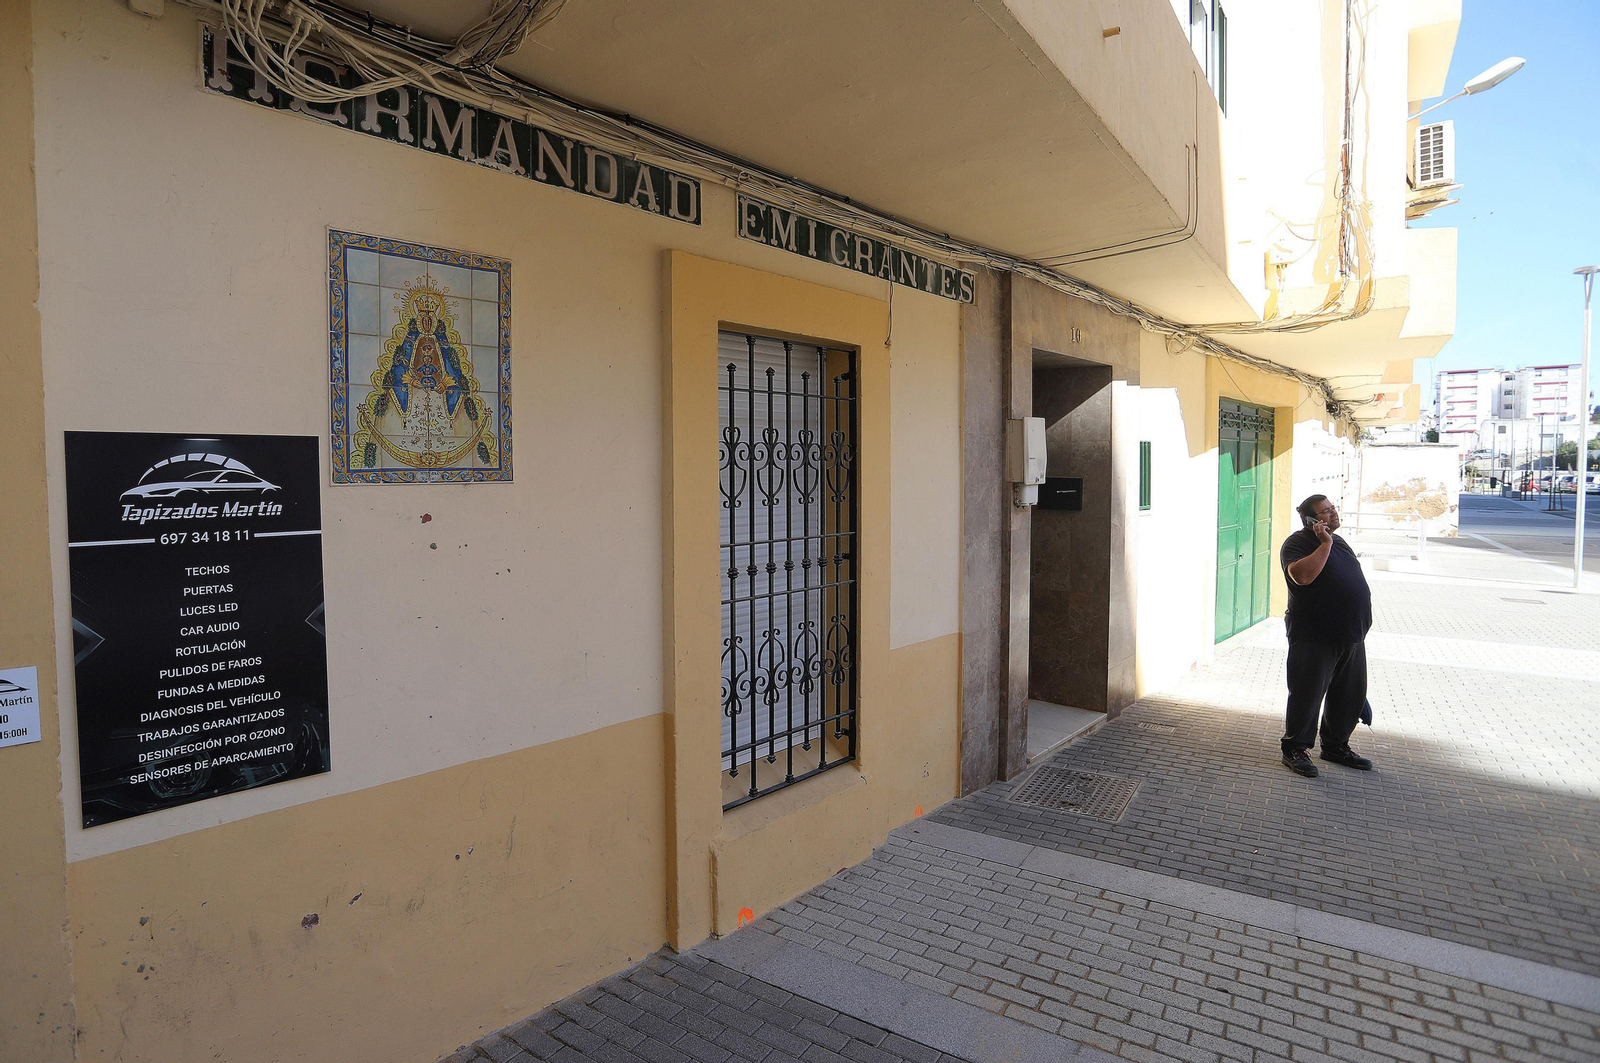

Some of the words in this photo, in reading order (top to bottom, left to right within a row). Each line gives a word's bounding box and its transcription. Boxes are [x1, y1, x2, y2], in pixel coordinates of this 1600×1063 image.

[738, 195, 975, 303] EMIGRANTES
[1070, 326, 1082, 344] 10
[121, 502, 219, 525] Tapizados
[221, 501, 283, 518] Martín
[160, 532, 188, 545] 697
[191, 531, 210, 544] 34
[213, 530, 231, 542] 18
[234, 529, 249, 541] 11
[184, 564, 231, 577] TECHOS
[183, 583, 234, 597] PUERTAS
[180, 604, 216, 617] LUCES
[218, 602, 239, 613] LED
[180, 625, 204, 637] CAR
[206, 621, 240, 633] AUDIO
[175, 639, 246, 657] ROTULACIÓN
[159, 664, 209, 680] PULIDOS
[211, 662, 226, 672] DE
[228, 656, 263, 670] FAROS
[157, 684, 205, 700] FUNDAS
[206, 682, 215, 692] A
[217, 674, 266, 690] MEDIDAS
[140, 703, 205, 723] DIAGNOSIS
[206, 699, 228, 711] DEL
[229, 690, 281, 707] VEHÍCULO
[137, 723, 200, 743] TRABAJOS
[202, 708, 285, 731] GARANTIZADOS
[138, 738, 222, 763] DESINFECCIÓN
[224, 733, 247, 746] POR
[249, 726, 286, 741] OZONO
[129, 764, 192, 785] SENSORES
[194, 759, 209, 771] DE
[211, 742, 294, 767] APARCAMIENTO
